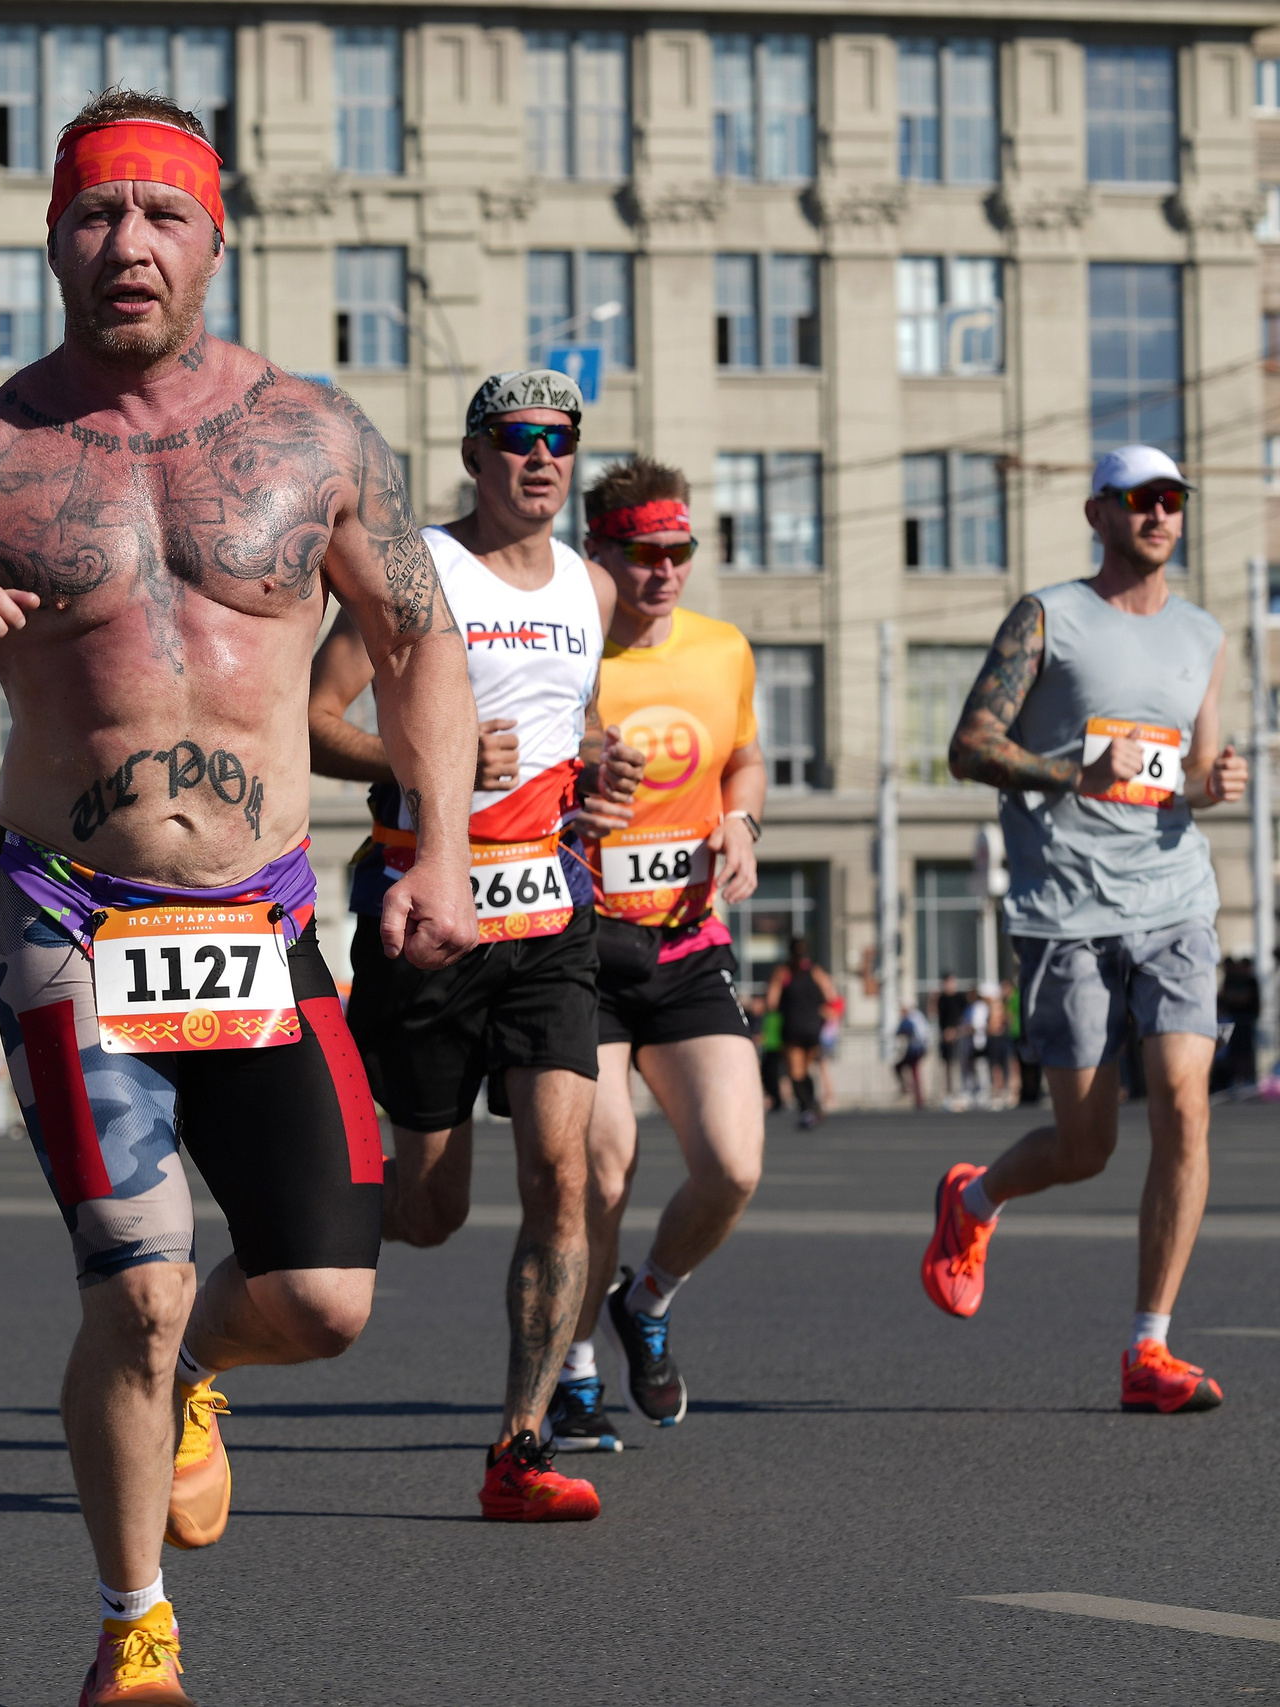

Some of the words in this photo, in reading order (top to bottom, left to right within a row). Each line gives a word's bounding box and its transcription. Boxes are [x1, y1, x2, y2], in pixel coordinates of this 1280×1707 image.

[386, 529, 417, 582] GATTI
[398, 551, 421, 586] ARTURO
[466, 621, 587, 656] РАКЕТЫ
[628, 850, 691, 883] 168
[469, 865, 561, 910] 2664
[128, 913, 245, 926] ПОЛУМАРАФОН
[125, 945, 261, 1002] 1127
